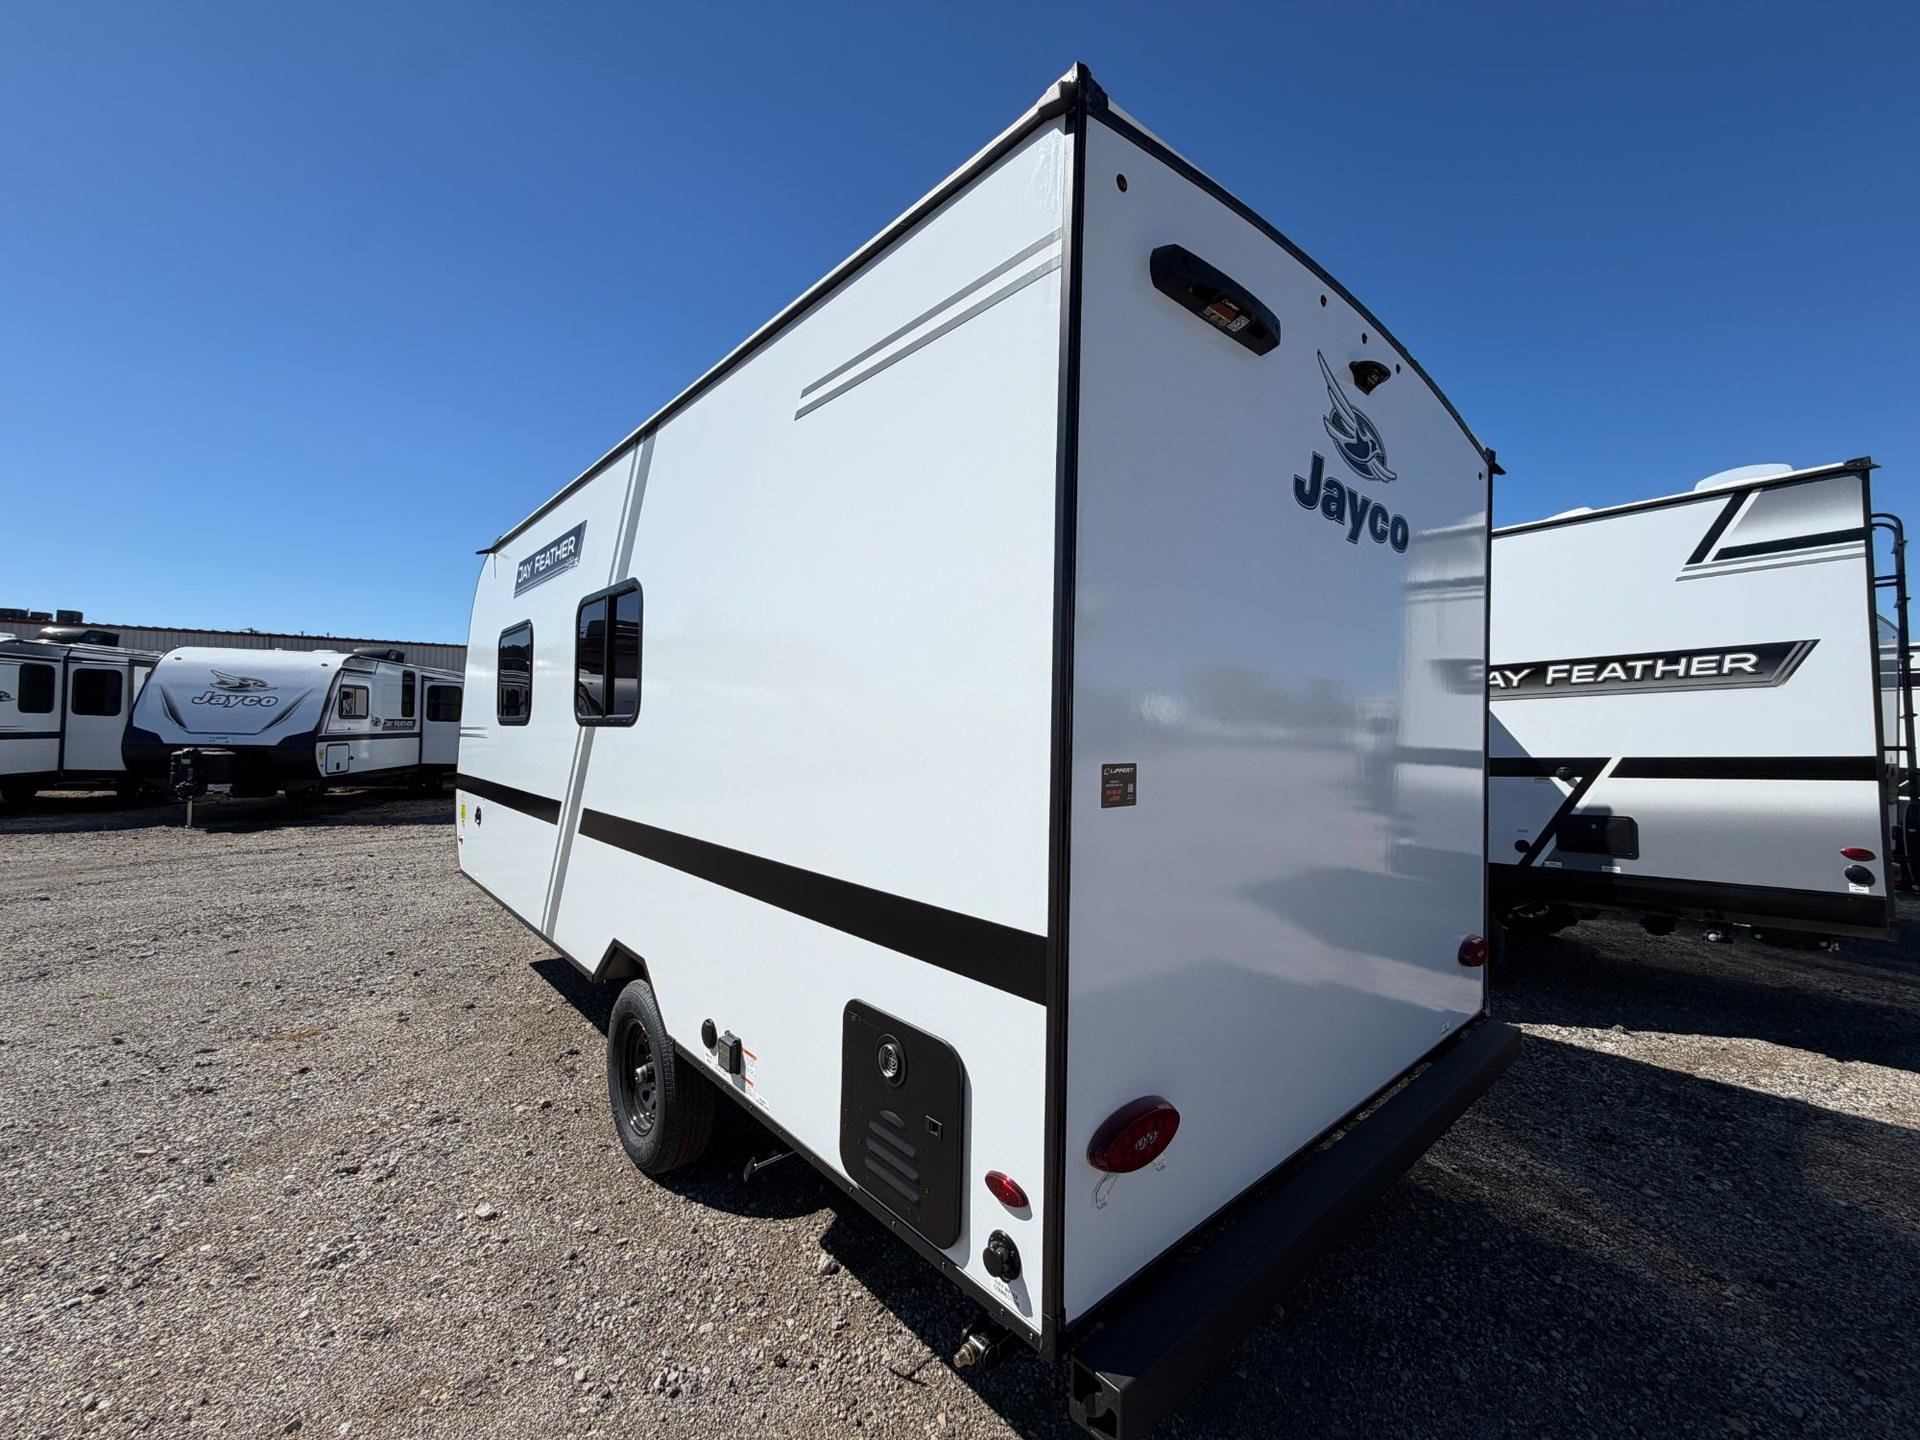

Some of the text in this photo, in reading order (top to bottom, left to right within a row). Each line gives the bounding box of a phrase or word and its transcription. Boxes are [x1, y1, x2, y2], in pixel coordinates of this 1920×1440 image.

[1293, 450, 1409, 554] Jayco
[518, 561, 533, 583] JAY
[534, 535, 576, 574] FEATHER
[1489, 652, 1760, 688] AY FEATHER
[192, 691, 279, 708] Jayco
